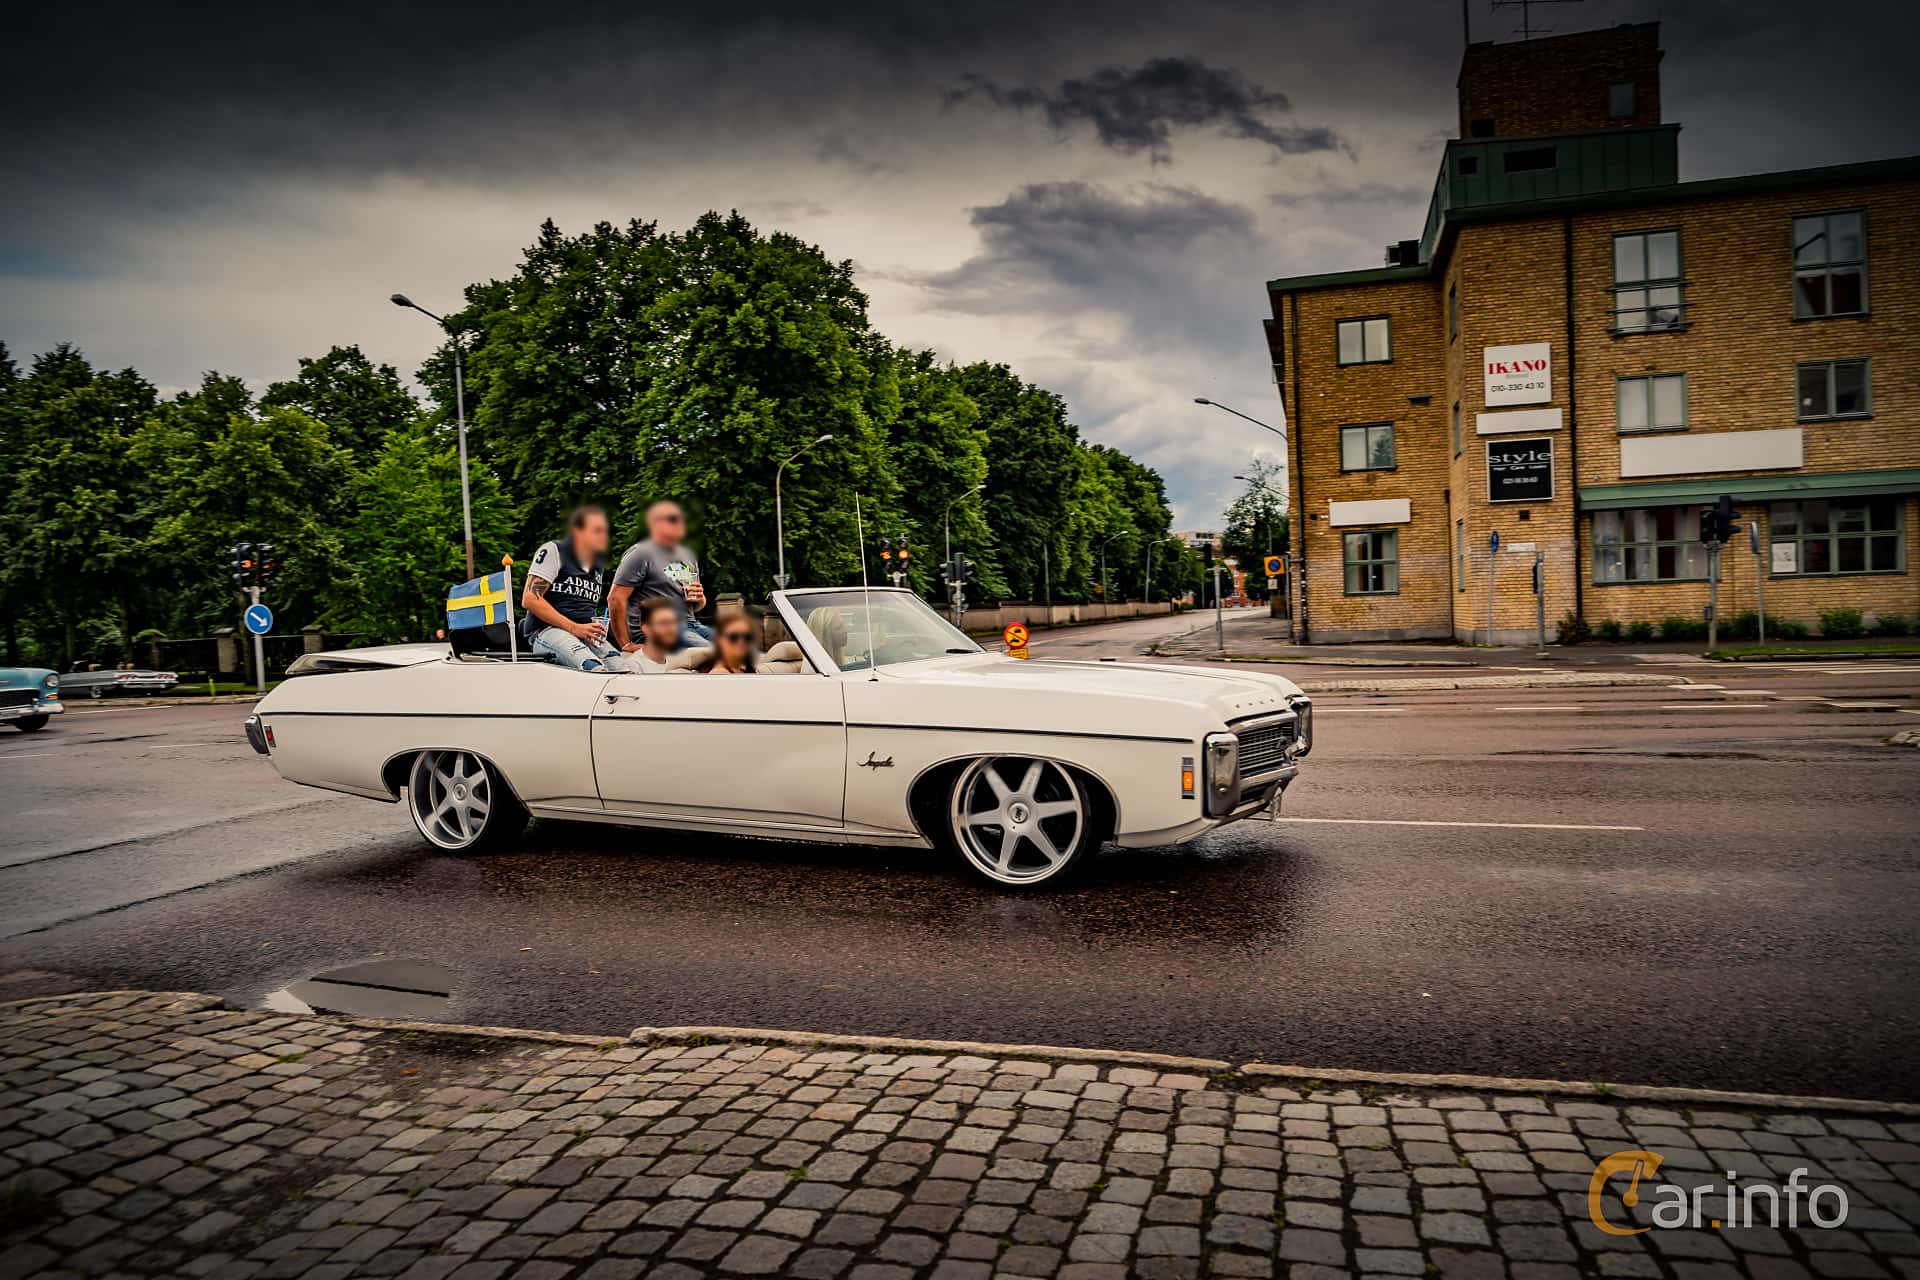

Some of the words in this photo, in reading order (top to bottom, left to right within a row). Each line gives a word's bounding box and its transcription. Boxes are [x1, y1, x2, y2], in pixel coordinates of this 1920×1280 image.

[1488, 359, 1547, 375] IKANO
[1487, 450, 1552, 465] style
[535, 549, 548, 564] 3
[551, 582, 601, 602] HAMMO
